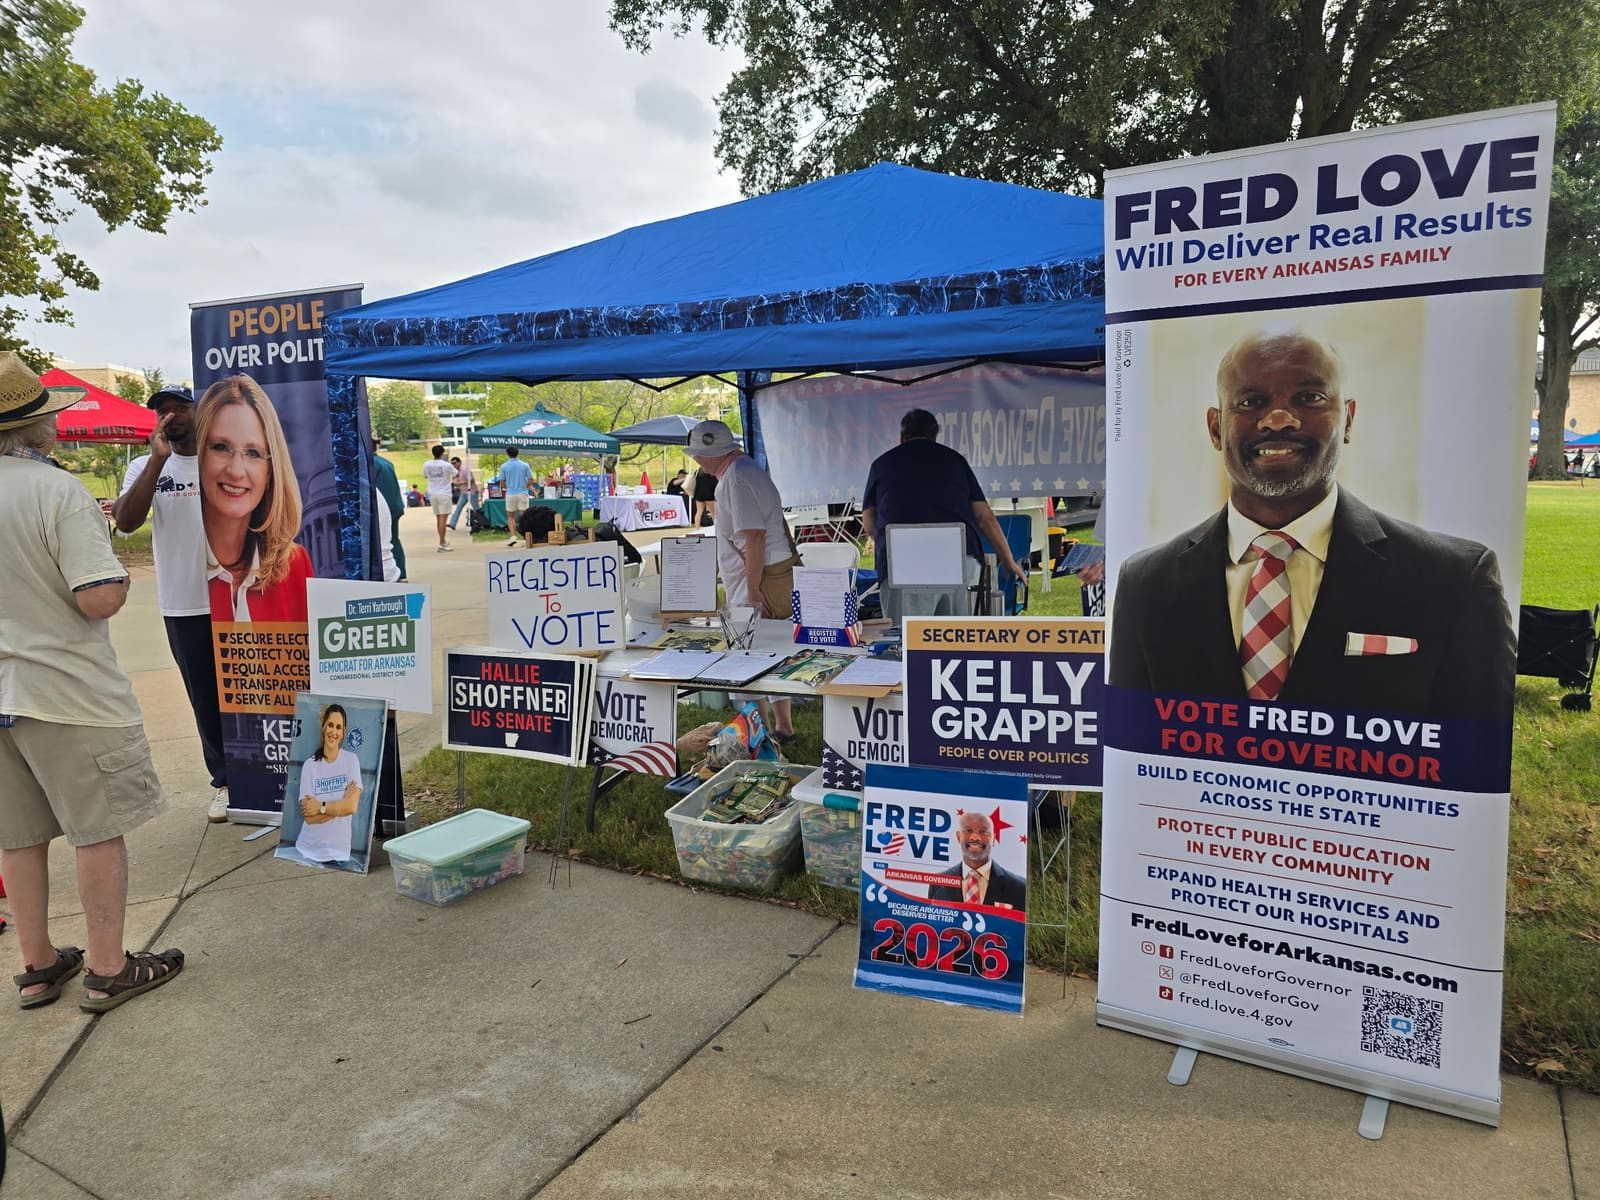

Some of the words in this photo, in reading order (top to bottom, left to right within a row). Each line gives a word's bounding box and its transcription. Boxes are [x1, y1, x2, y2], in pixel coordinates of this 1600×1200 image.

[1115, 173, 1298, 240] FRED
[1316, 135, 1539, 216] LOVE
[1116, 242, 1173, 271] Will
[1182, 232, 1299, 264] Deliver
[1309, 216, 1383, 250] Real
[1394, 201, 1532, 240] Results
[1174, 273, 1208, 289] FOR
[1212, 266, 1268, 285] EVERY
[1272, 254, 1374, 279] ARKANSAS
[1381, 247, 1452, 266] FAMILY
[229, 300, 324, 337] PEOPLE
[205, 344, 263, 370] OVER
[482, 436, 608, 449] www.shopsoutherngent.com
[488, 555, 617, 593] REGISTER
[348, 604, 357, 615] Dr.
[358, 602, 371, 614] Terri
[372, 600, 403, 614] Yarbrough
[230, 632, 273, 644] SECURE
[512, 610, 616, 649] VOTE
[922, 628, 1020, 644] SECRETARY
[1026, 628, 1050, 644] OF
[231, 648, 282, 660] PROTECT
[232, 663, 270, 677] EQUAL
[319, 659, 358, 673] DEMOCRAT
[359, 658, 373, 671] FOR
[374, 656, 416, 670] ARKANSAS
[330, 672, 371, 680] CONGRESSIONAL
[481, 662, 541, 684] HALLIE
[931, 658, 1096, 706] KELLY
[236, 693, 270, 705] SERVE
[274, 694, 295, 706] ALL
[455, 682, 567, 714] SHOFFNER
[596, 681, 647, 723] VOTE
[471, 710, 491, 727] US
[496, 712, 552, 733] SENATE
[591, 721, 654, 743] DEMOCRAT
[931, 706, 1098, 745] GRAPPE
[1154, 698, 1238, 727] VOTE
[1249, 706, 1334, 736] FRED
[1346, 715, 1442, 748] LOVE
[939, 746, 985, 760] PEOPLE
[988, 749, 1024, 762] OVER
[1029, 751, 1089, 764] POLITICS
[1161, 729, 1225, 756] FOR
[1237, 736, 1442, 782] GOVERNOR
[1137, 763, 1188, 781] BUILD
[1193, 771, 1291, 795] ECONOMIC
[1296, 783, 1460, 818] OPPORTUNITIES
[866, 802, 952, 833] FRED
[1200, 791, 1273, 812] ACROSS
[1279, 800, 1314, 818] THE
[1319, 807, 1381, 828] STATE
[1157, 817, 1236, 841] PROTECT
[1242, 829, 1307, 852] PUBLIC
[1312, 840, 1431, 872] EDUCATION
[1187, 839, 1204, 855] IN
[1209, 845, 1266, 865] EVERY
[1272, 854, 1394, 886] COMMUNITY
[886, 870, 922, 881] ARKANSAS
[923, 876, 961, 886] GOVERNOR
[888, 902, 919, 912] BECAUSE
[919, 907, 959, 917] ARKANSAS
[892, 909, 927, 920] DESERVES
[928, 912, 955, 923] BETTER
[1147, 866, 1217, 889] EXPAND
[1222, 877, 1292, 902] HEALTH
[1296, 890, 1389, 920] SERVICES
[1395, 909, 1440, 930] AND
[1171, 887, 1250, 914] PROTECT
[1255, 903, 1295, 923] OUR
[1300, 912, 1409, 945] HOSPITALS
[870, 918, 1009, 980] 2026
[1130, 912, 1459, 994] FredLoveforArkansas.com
[1180, 949, 1352, 998] FredLoveforGovernor
[1178, 991, 1293, 1029] fred.love.4.gov
[1179, 972, 1320, 1013] @FredLoveforGov
